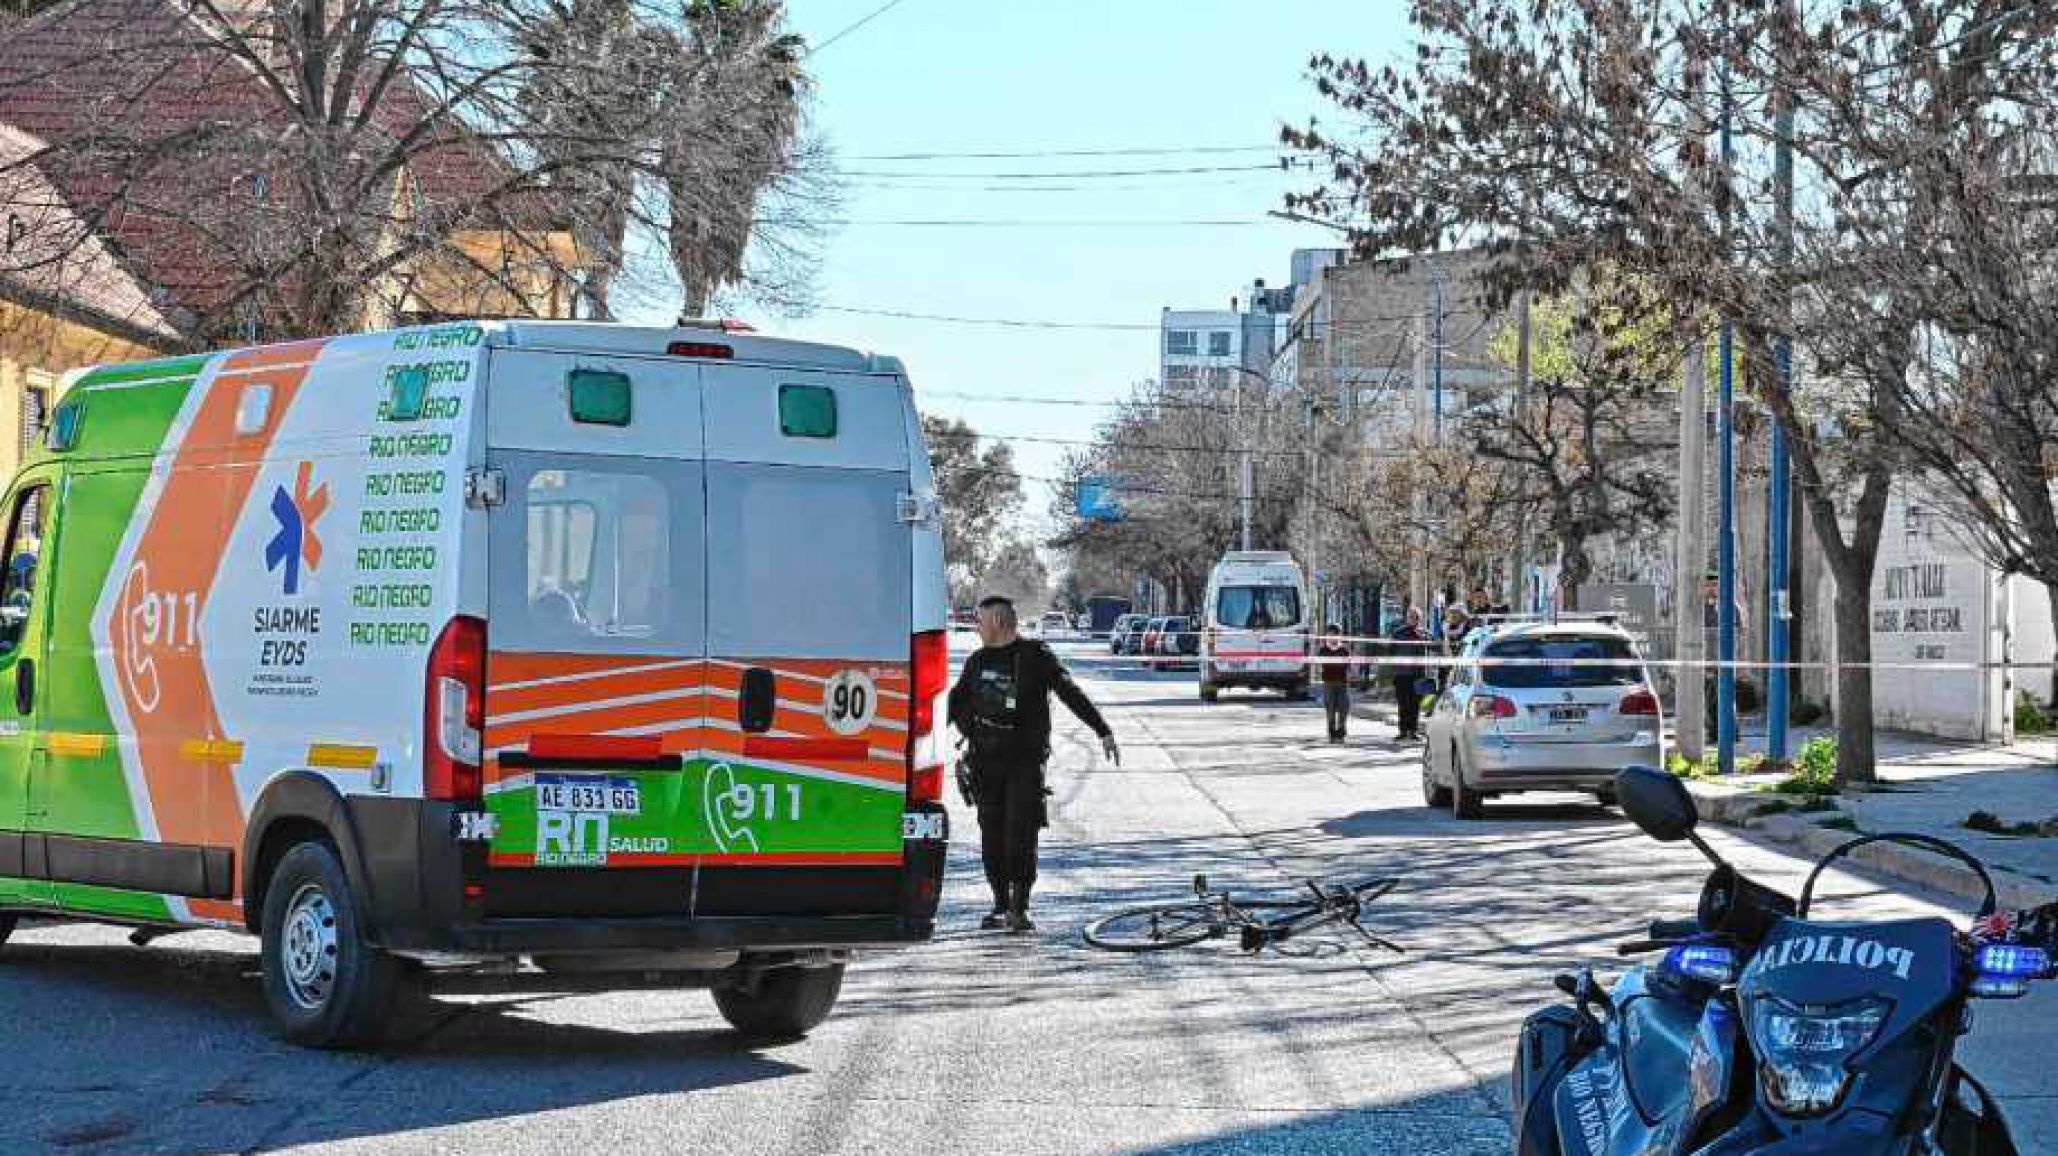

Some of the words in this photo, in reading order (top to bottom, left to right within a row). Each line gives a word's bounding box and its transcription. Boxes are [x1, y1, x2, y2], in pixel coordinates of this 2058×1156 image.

[368, 436, 395, 458] RIO
[397, 433, 453, 456] NEGRO
[366, 474, 392, 496] RIO
[393, 470, 446, 495] NEGRO
[359, 510, 386, 534] RIO
[387, 508, 441, 533] NEGRO
[356, 547, 381, 570] RIO
[382, 546, 436, 570] NEGRO
[352, 584, 379, 608] RIO
[380, 583, 433, 610] NEGRO
[142, 591, 199, 645] 911
[253, 606, 321, 634] SIARME
[350, 622, 375, 648] RIO
[377, 621, 430, 648] NEGRO
[260, 640, 308, 666] EYDS
[832, 683, 867, 721] 90
[542, 784, 565, 808] AE
[732, 783, 802, 822] 911
[610, 836, 669, 854] SALUD
